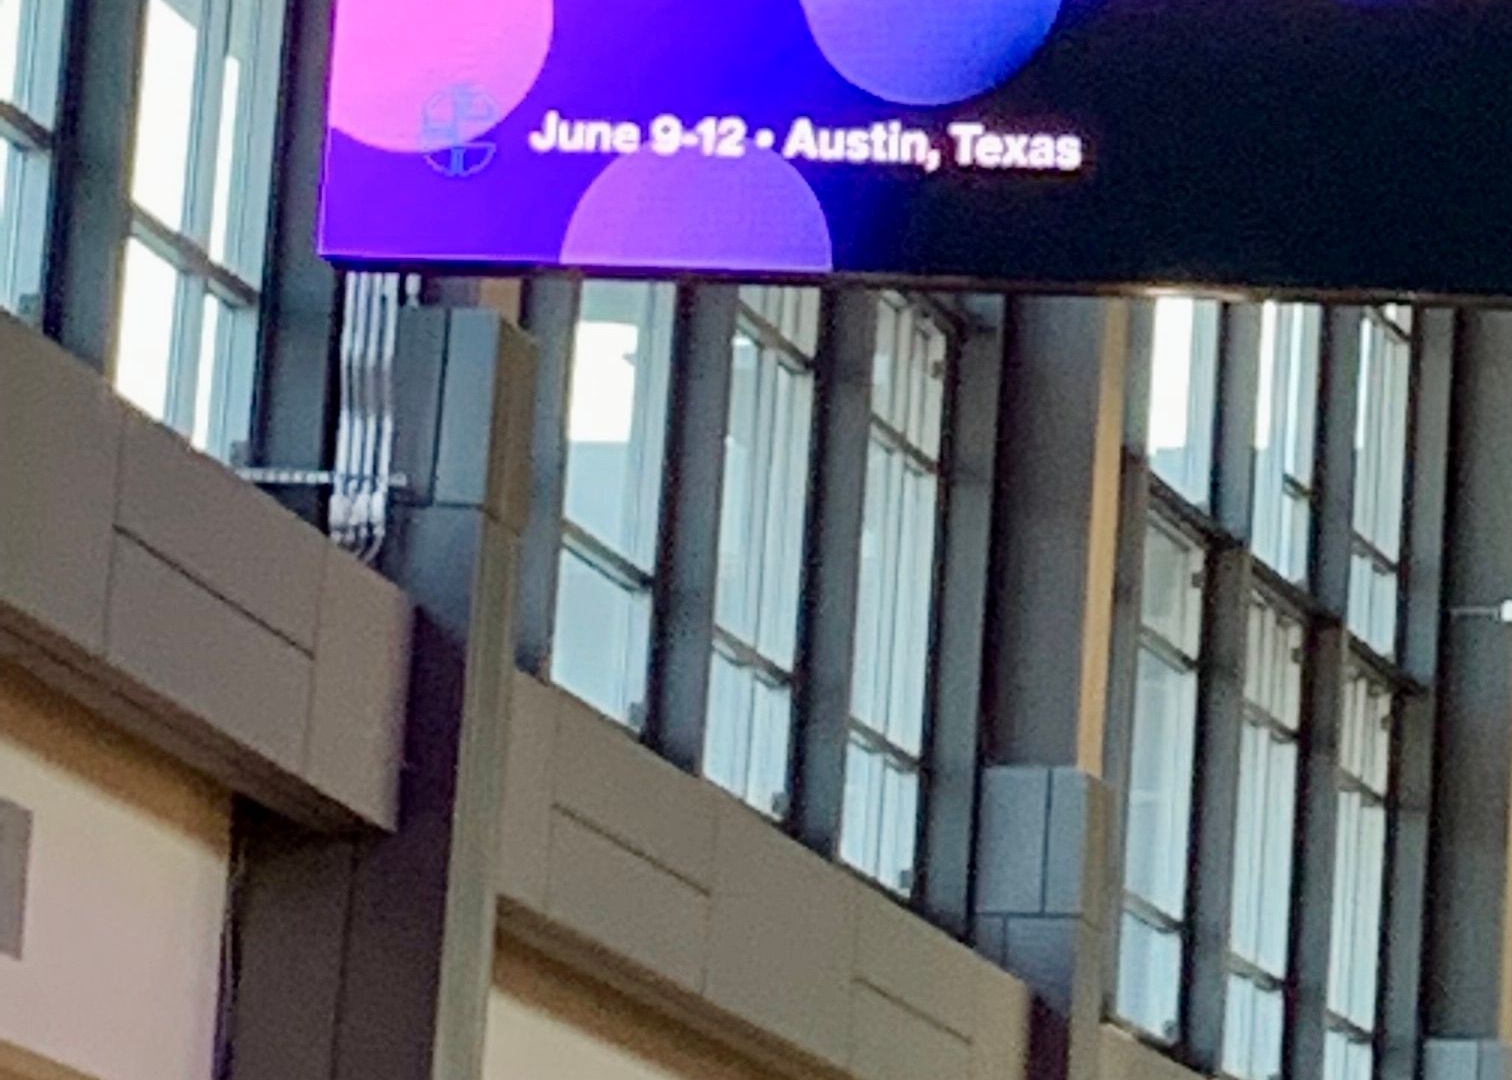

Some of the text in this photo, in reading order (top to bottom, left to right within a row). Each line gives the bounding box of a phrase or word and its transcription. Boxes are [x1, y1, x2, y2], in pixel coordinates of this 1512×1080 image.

[529, 111, 639, 153] June
[651, 115, 747, 157] 9-12
[784, 119, 940, 172] Austin,
[947, 123, 1083, 171] Texas
